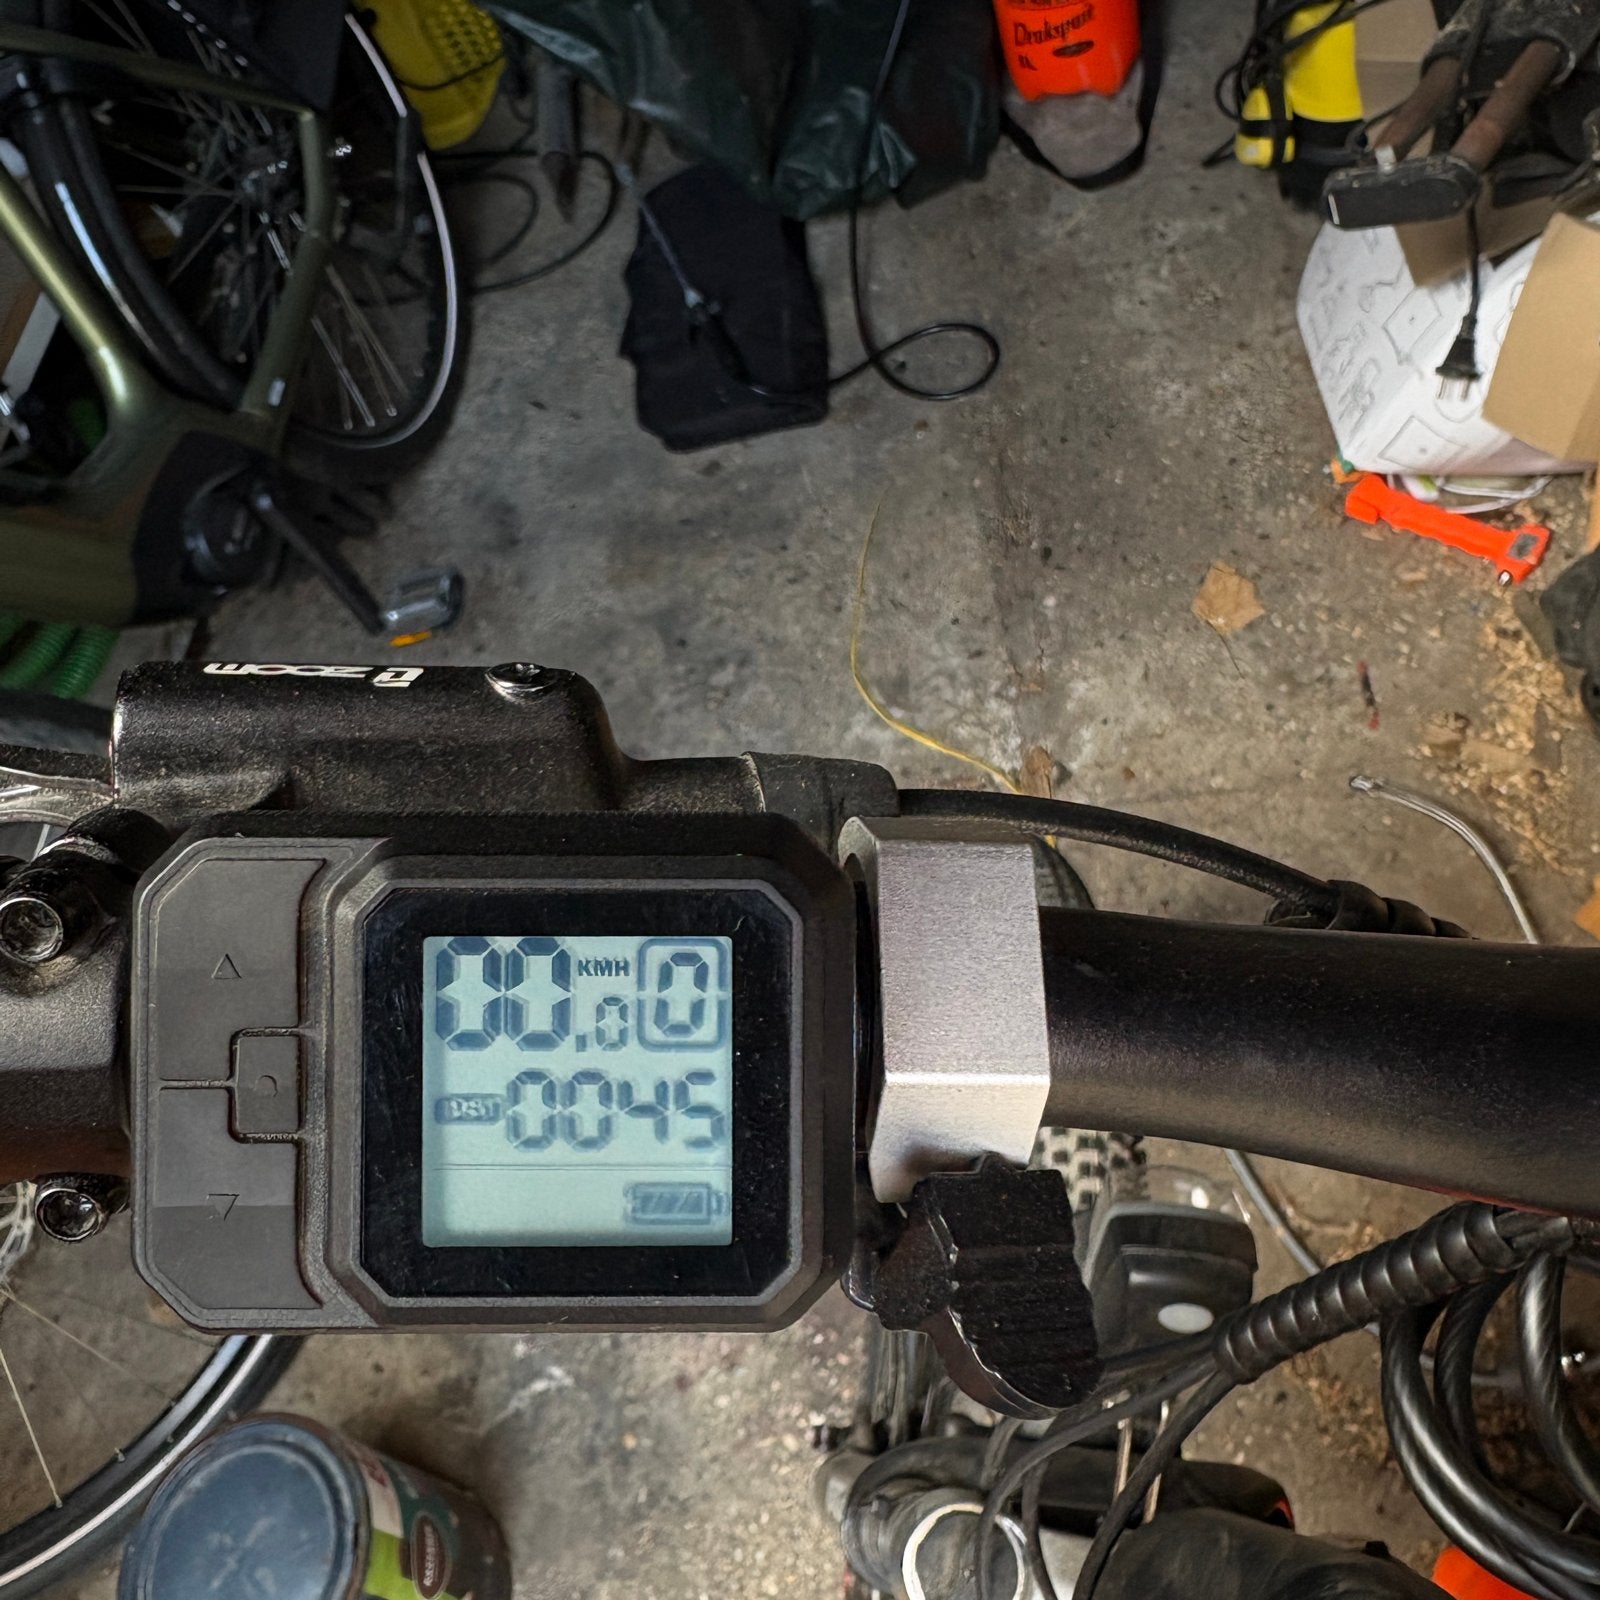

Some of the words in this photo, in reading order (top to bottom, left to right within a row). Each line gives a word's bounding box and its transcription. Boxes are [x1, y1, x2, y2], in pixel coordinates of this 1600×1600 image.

[577, 957, 631, 977] KMH
[653, 951, 710, 1037] 0
[506, 1070, 725, 1151] 0045
